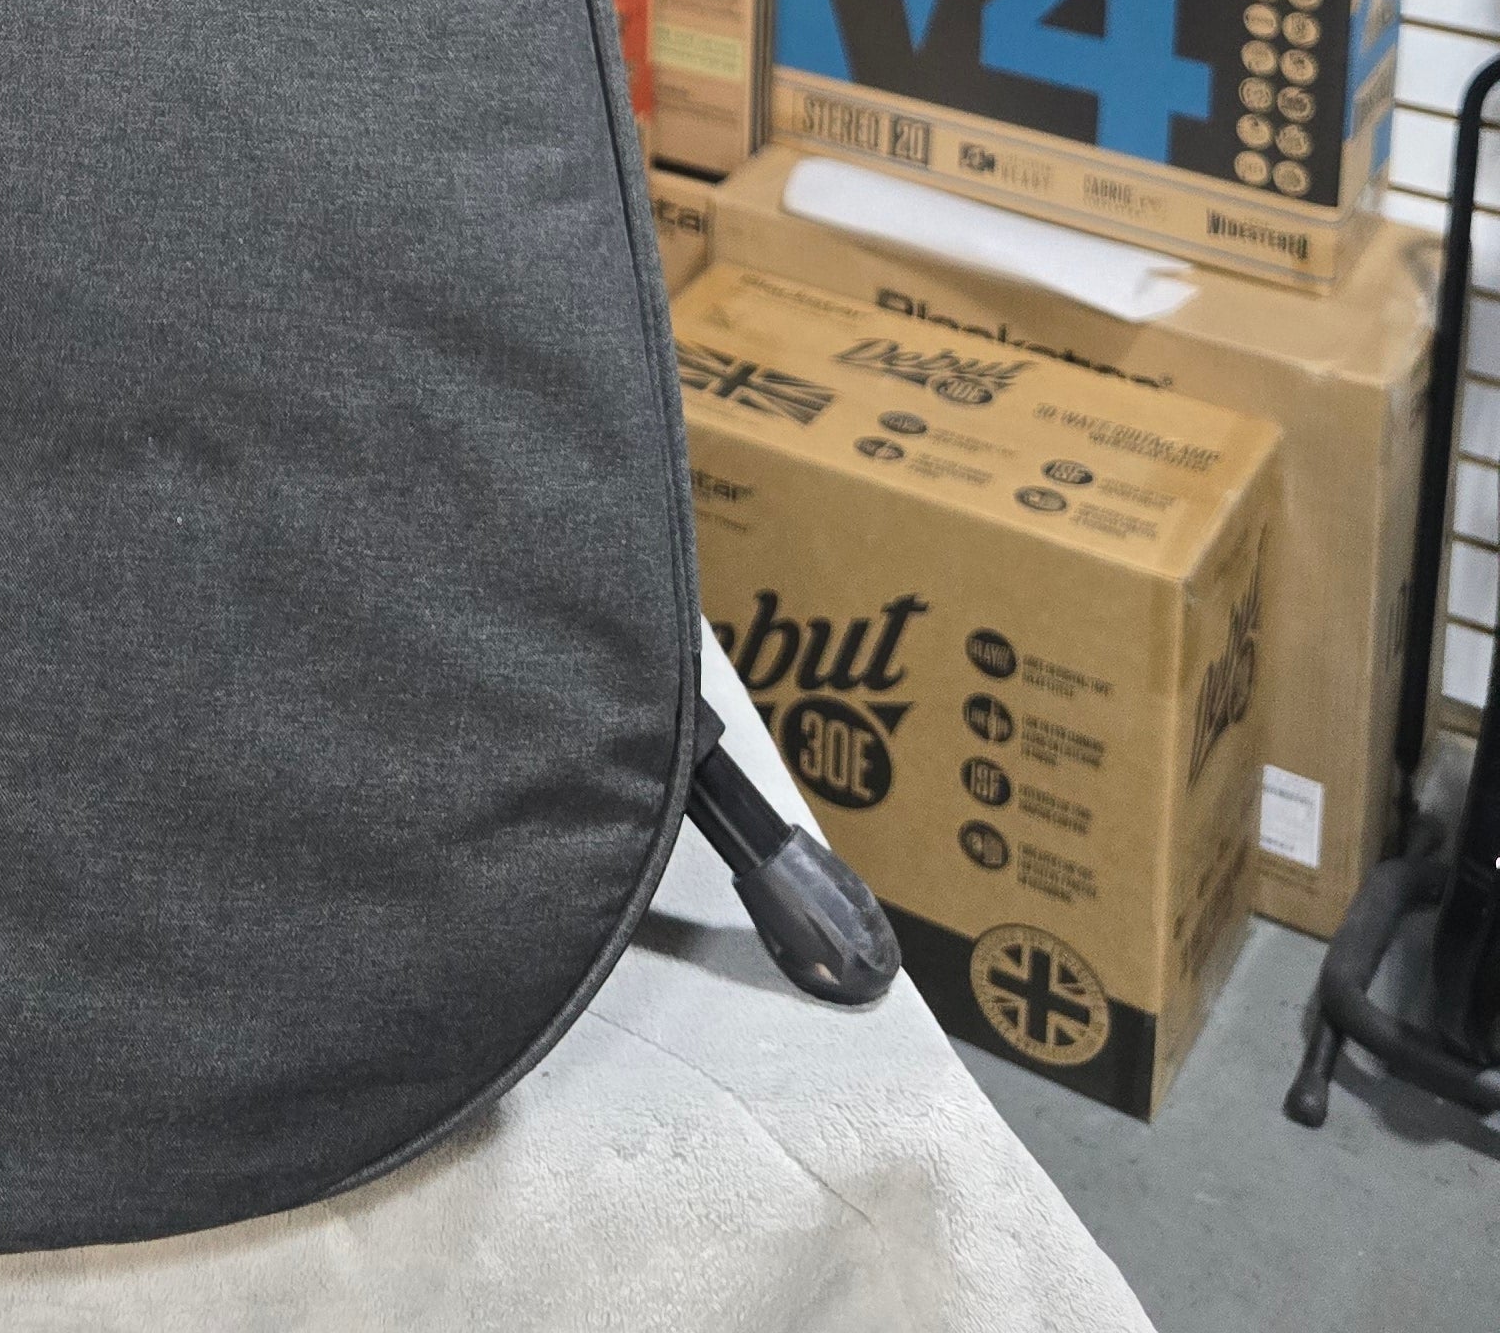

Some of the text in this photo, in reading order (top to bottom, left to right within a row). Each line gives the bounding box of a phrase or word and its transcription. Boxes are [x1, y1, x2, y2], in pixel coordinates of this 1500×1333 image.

[803, 95, 926, 162] STEREO 20
[800, 710, 878, 802] 30E
